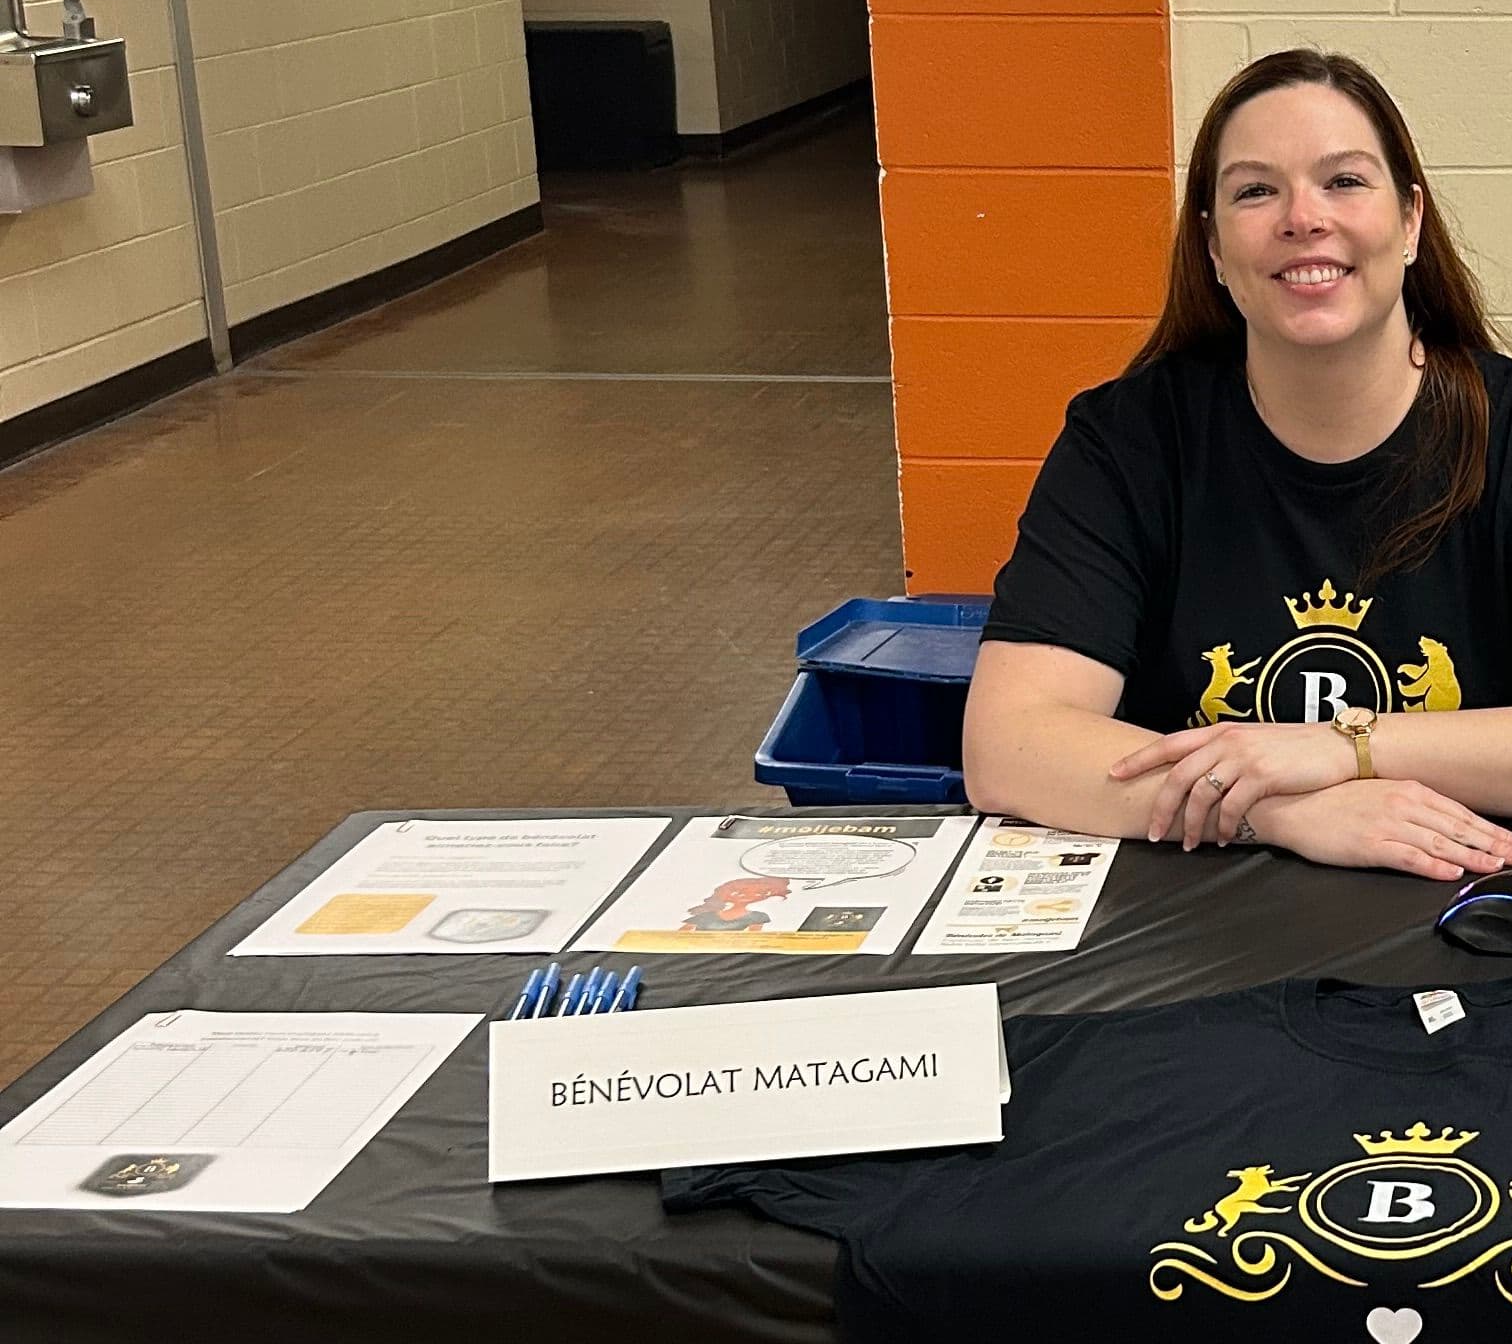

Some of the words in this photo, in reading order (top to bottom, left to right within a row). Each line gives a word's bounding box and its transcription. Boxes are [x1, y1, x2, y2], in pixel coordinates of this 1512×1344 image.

[1300, 671, 1351, 723] B
[757, 824, 897, 835] #moijebam
[551, 1068, 743, 1108] BÉNÉVOLAT
[753, 1053, 939, 1093] MATAGAMI
[1358, 1180, 1437, 1224] B
